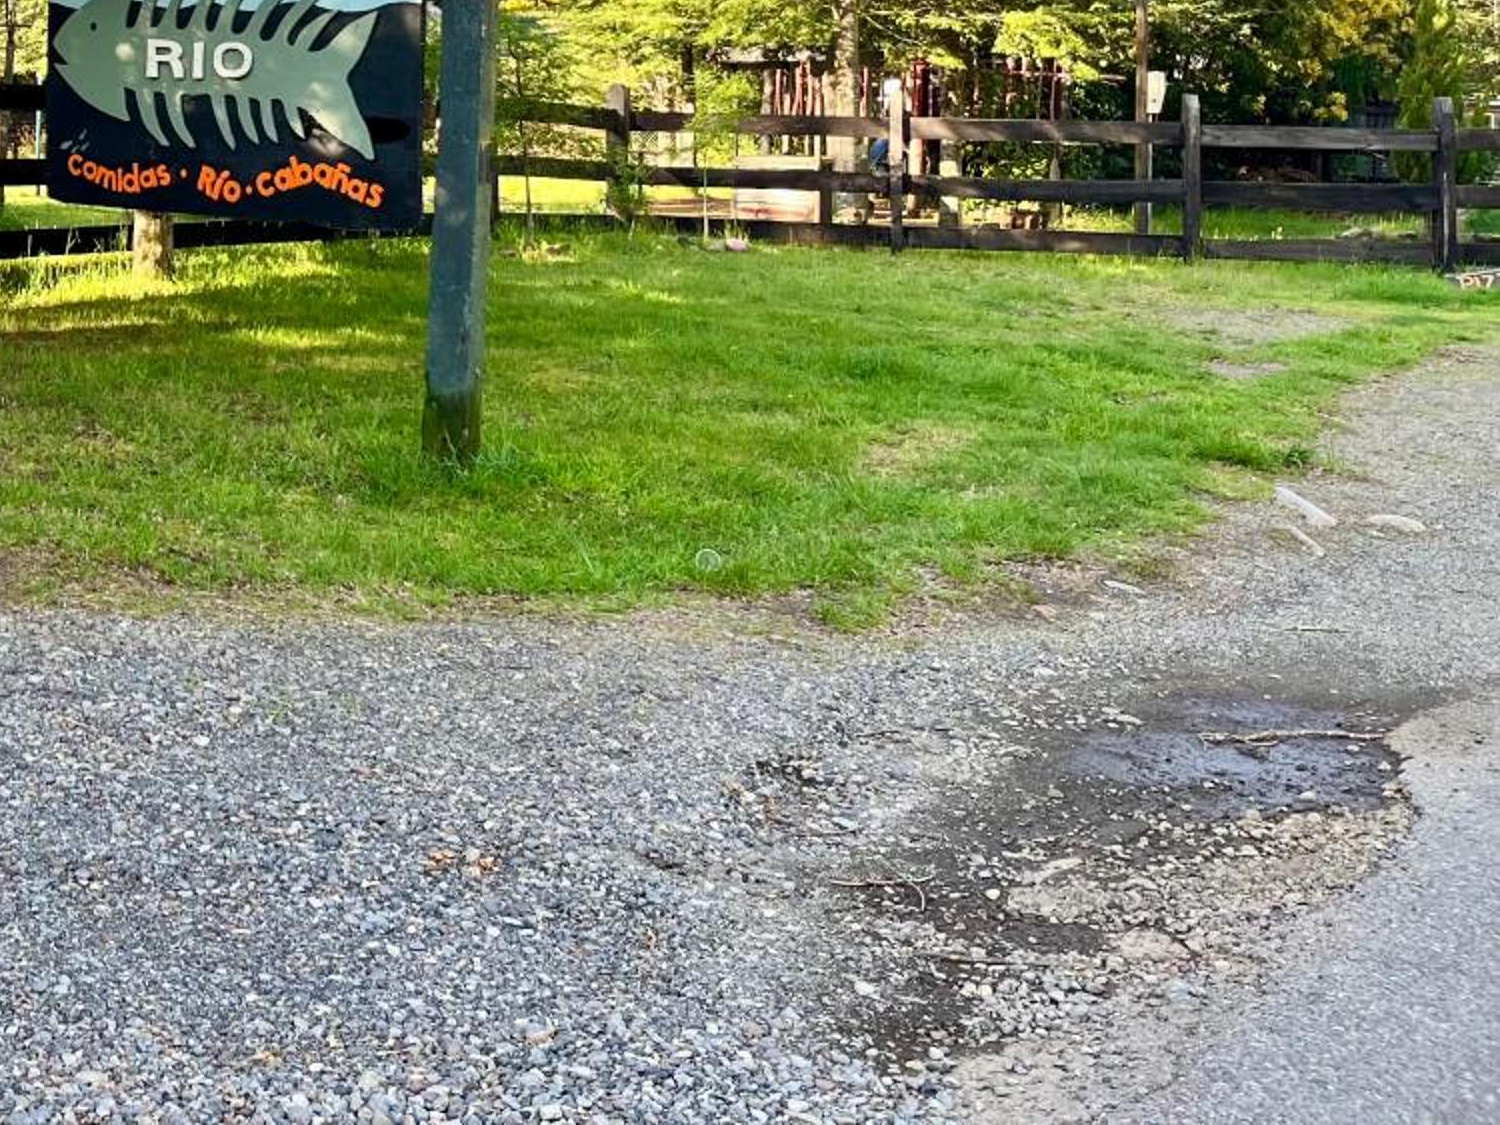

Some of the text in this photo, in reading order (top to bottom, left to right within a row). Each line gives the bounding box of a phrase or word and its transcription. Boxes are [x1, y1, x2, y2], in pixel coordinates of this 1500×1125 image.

[145, 39, 254, 80] RIO
[66, 154, 172, 194] Comidas
[196, 163, 242, 203] Río
